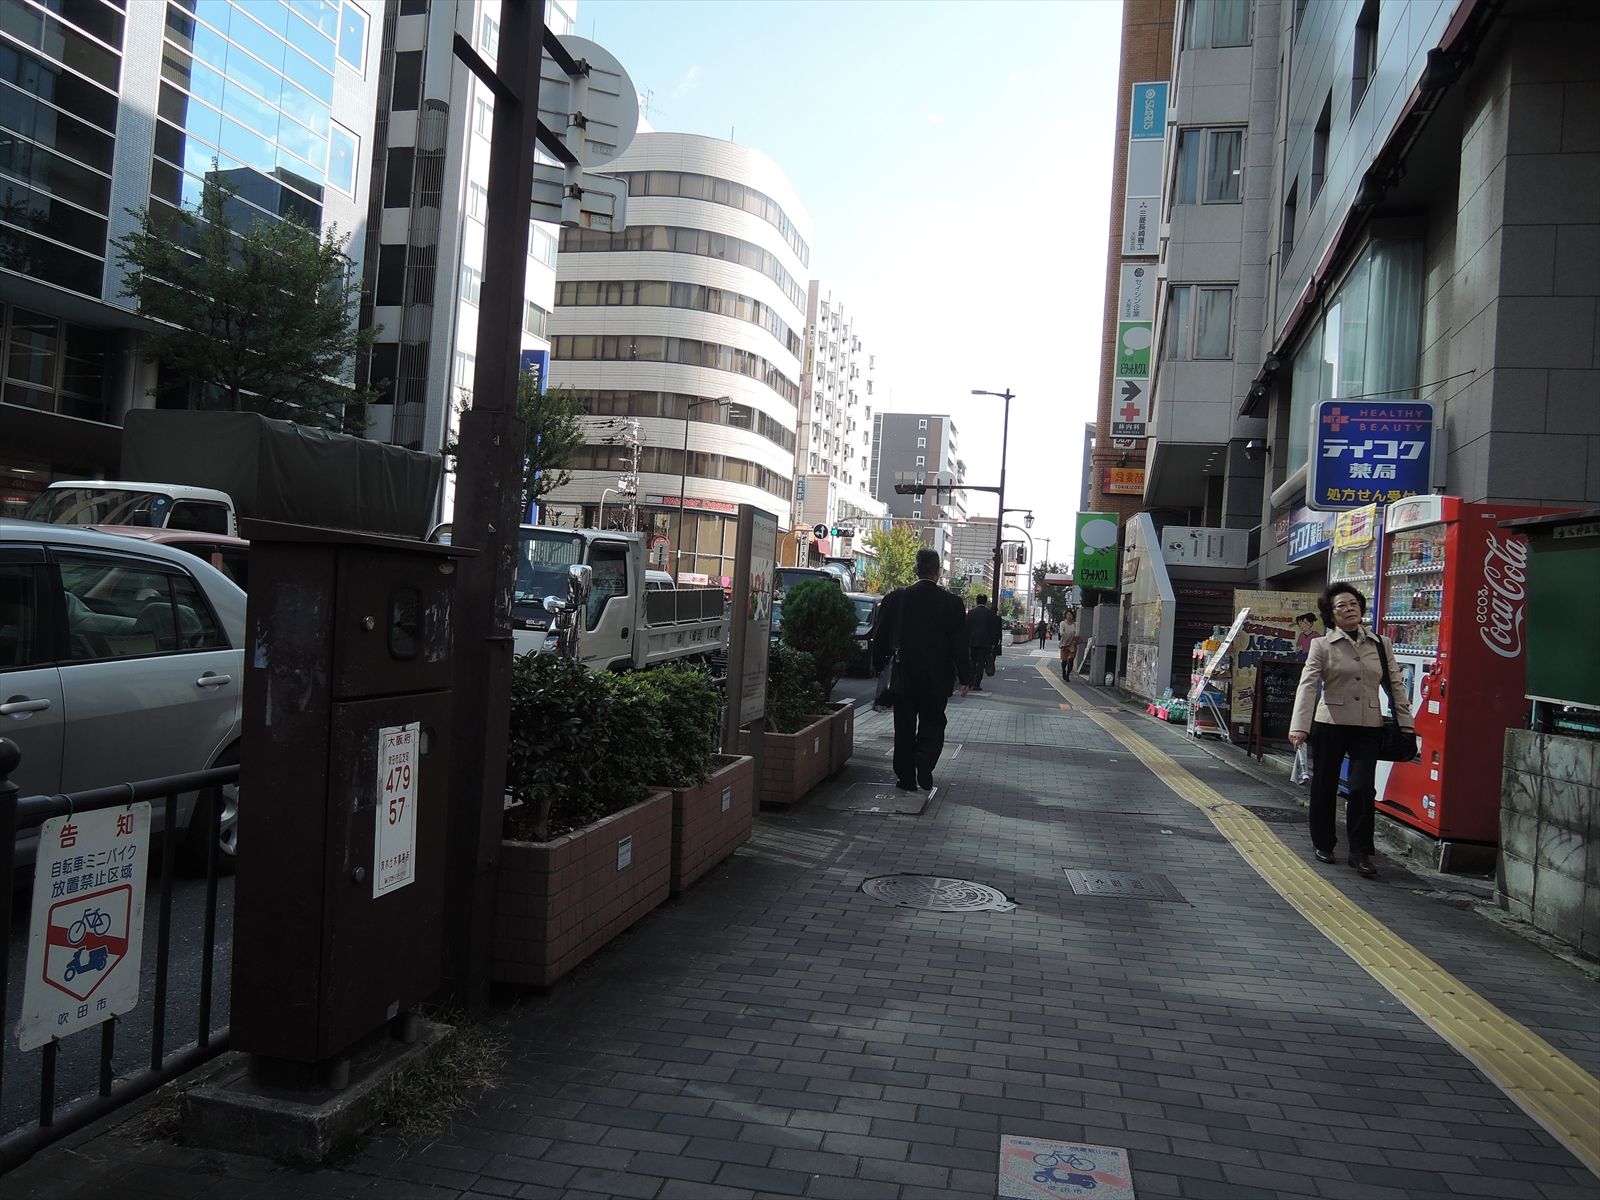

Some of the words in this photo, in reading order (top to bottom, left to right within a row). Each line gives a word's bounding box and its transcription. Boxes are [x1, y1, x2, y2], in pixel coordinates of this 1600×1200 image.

[1360, 409, 1424, 418] HEALTHY
[1360, 423, 1424, 432] BEAUTY
[1323, 439, 1425, 460] テイコク
[1349, 463, 1396, 480] 薬局
[1081, 568, 1109, 581] ピタットハウス
[388, 733, 411, 748] 大阪府
[386, 764, 411, 793] 479
[389, 797, 406, 825] 57
[51, 863, 133, 899] 放置禁止区域
[57, 998, 107, 1026] 吹田市
